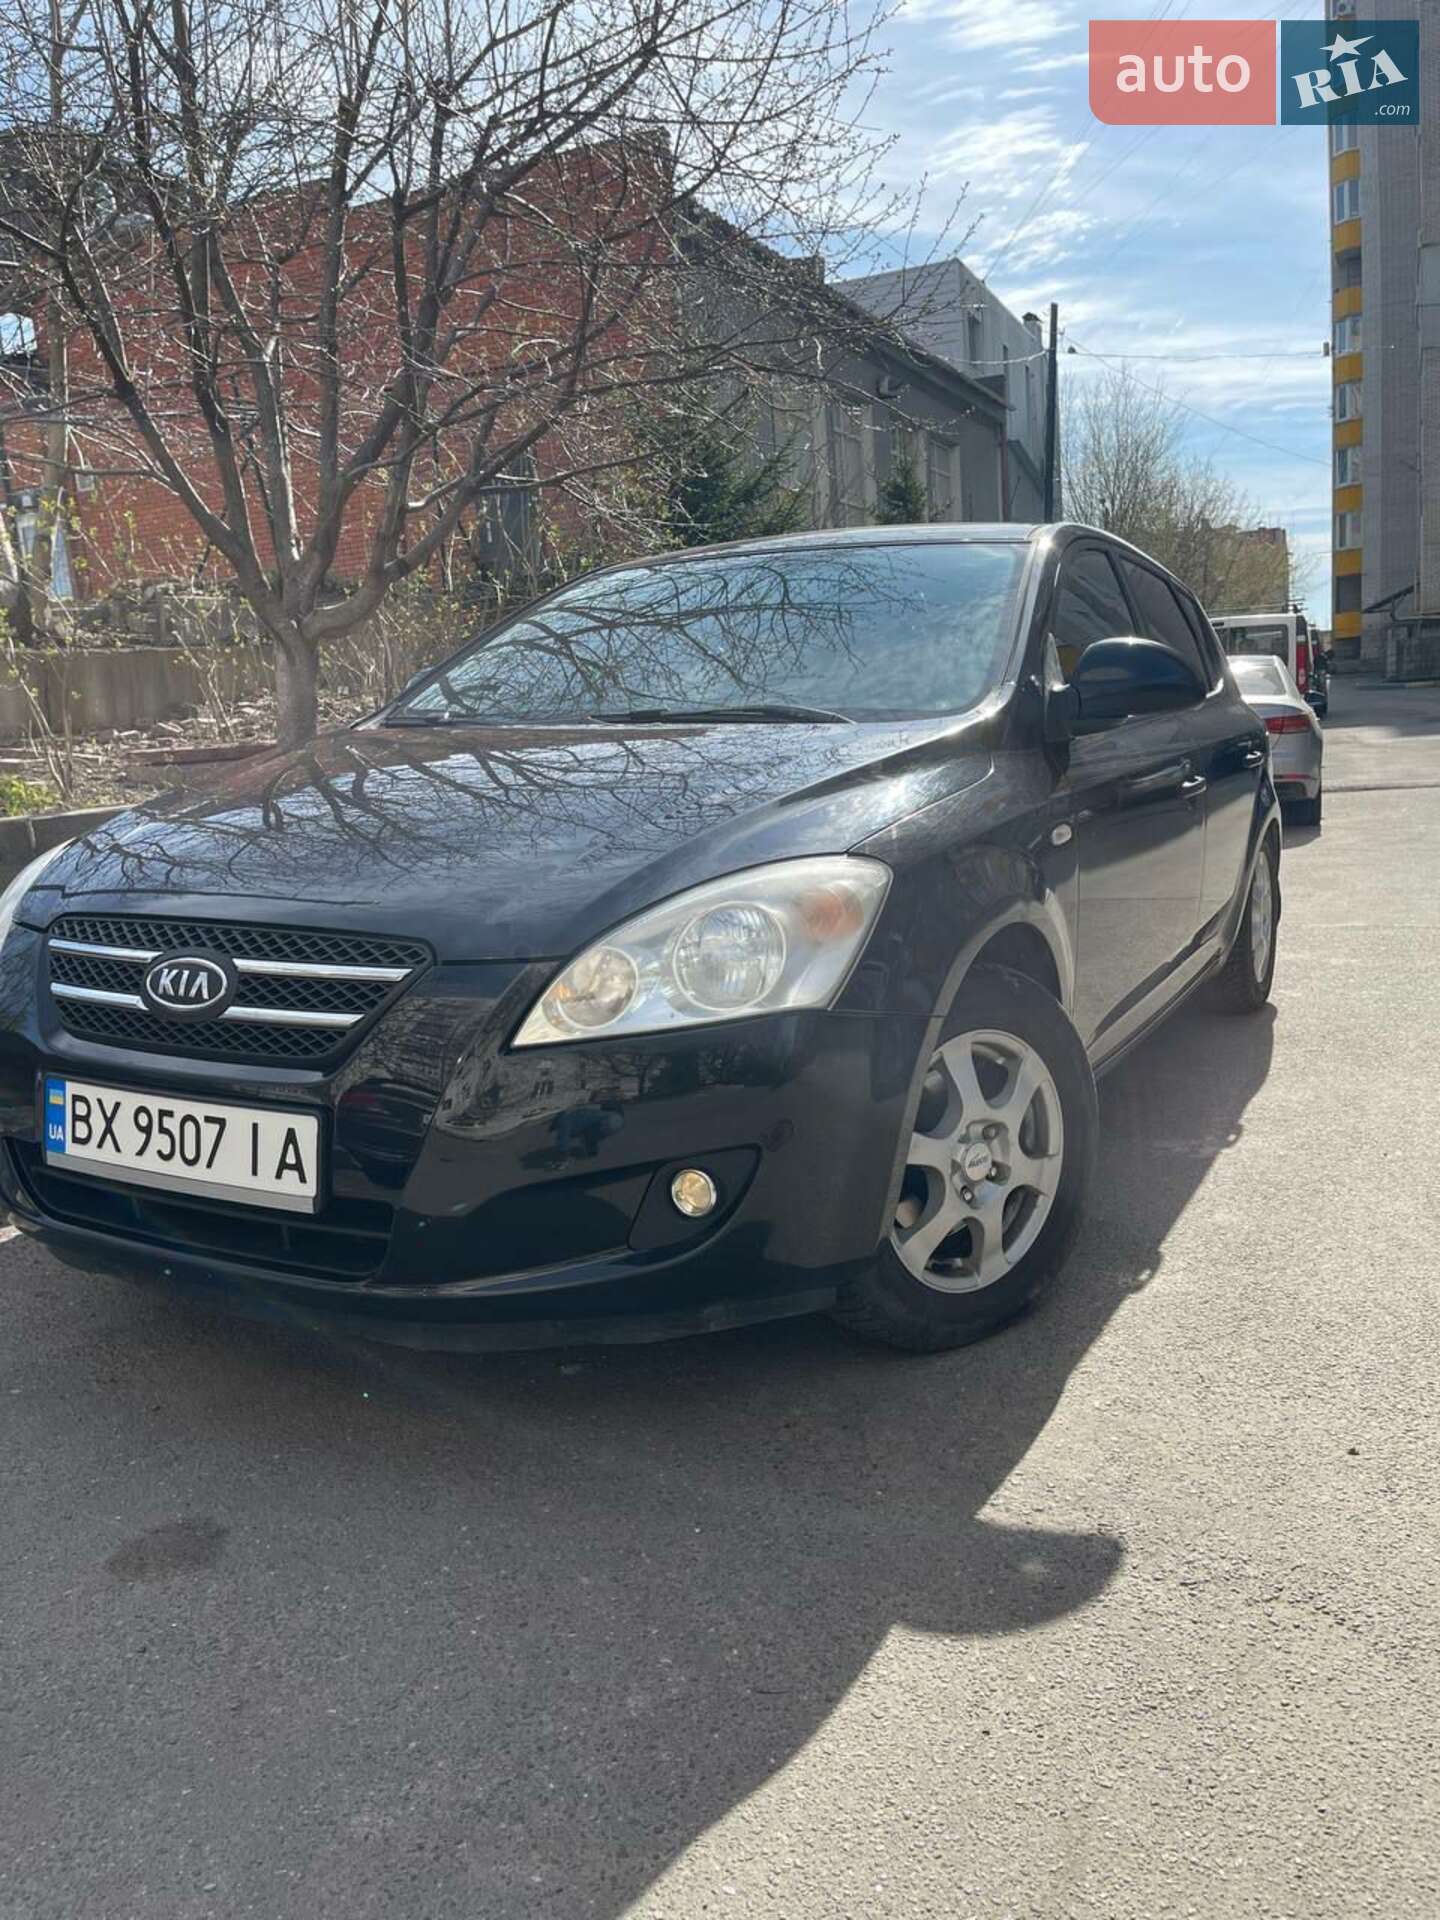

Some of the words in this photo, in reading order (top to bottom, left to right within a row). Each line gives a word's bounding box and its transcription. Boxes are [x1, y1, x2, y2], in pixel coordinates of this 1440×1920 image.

[158, 968, 209, 999] KIA
[49, 1122, 64, 1140] UA
[71, 1095, 122, 1153] BX
[133, 1105, 227, 1169] 9507
